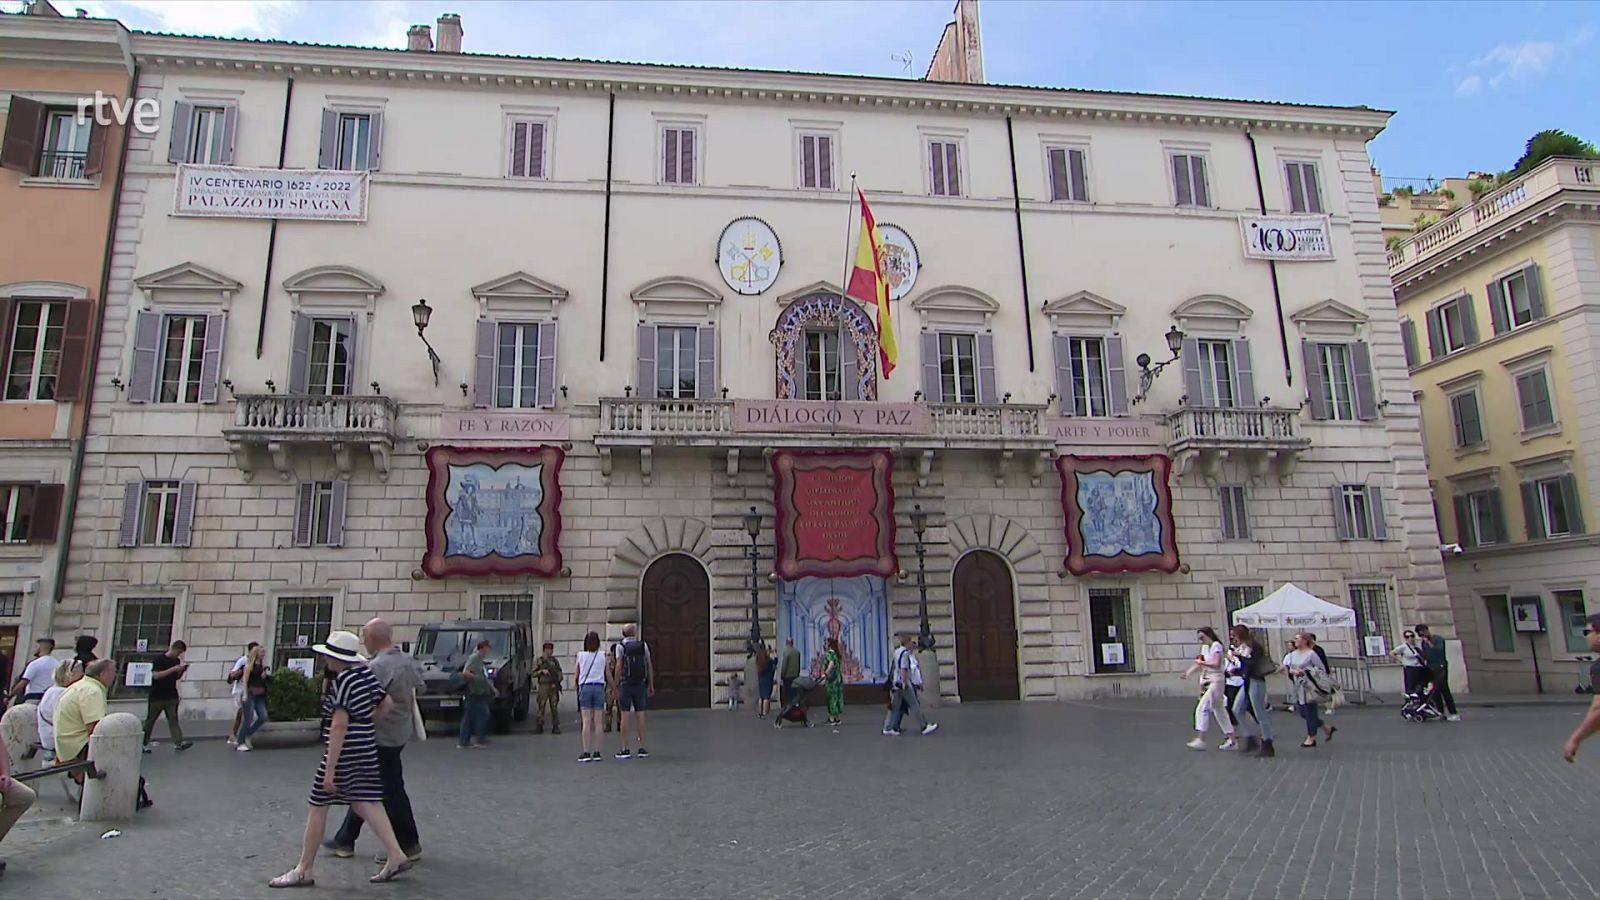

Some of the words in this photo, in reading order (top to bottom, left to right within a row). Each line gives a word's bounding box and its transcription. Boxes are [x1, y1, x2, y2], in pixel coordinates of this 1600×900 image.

[190, 177, 202, 186] IV
[205, 178, 283, 190] CENTENARIO
[287, 181, 312, 191] 1622
[323, 182, 351, 191] 2022
[189, 195, 263, 208] PALAZZO
[268, 198, 283, 208] DI
[289, 199, 351, 210] SPAGNA
[747, 405, 842, 424] DIÁLOGO
[853, 409, 864, 424] Y
[876, 409, 912, 426] PAZ
[459, 419, 475, 431] FE
[484, 420, 493, 431] Y
[501, 418, 553, 432] RAZÓN
[1055, 426, 1087, 437] ARTE
[1093, 426, 1102, 437] Y
[1108, 426, 1151, 438] PODER
